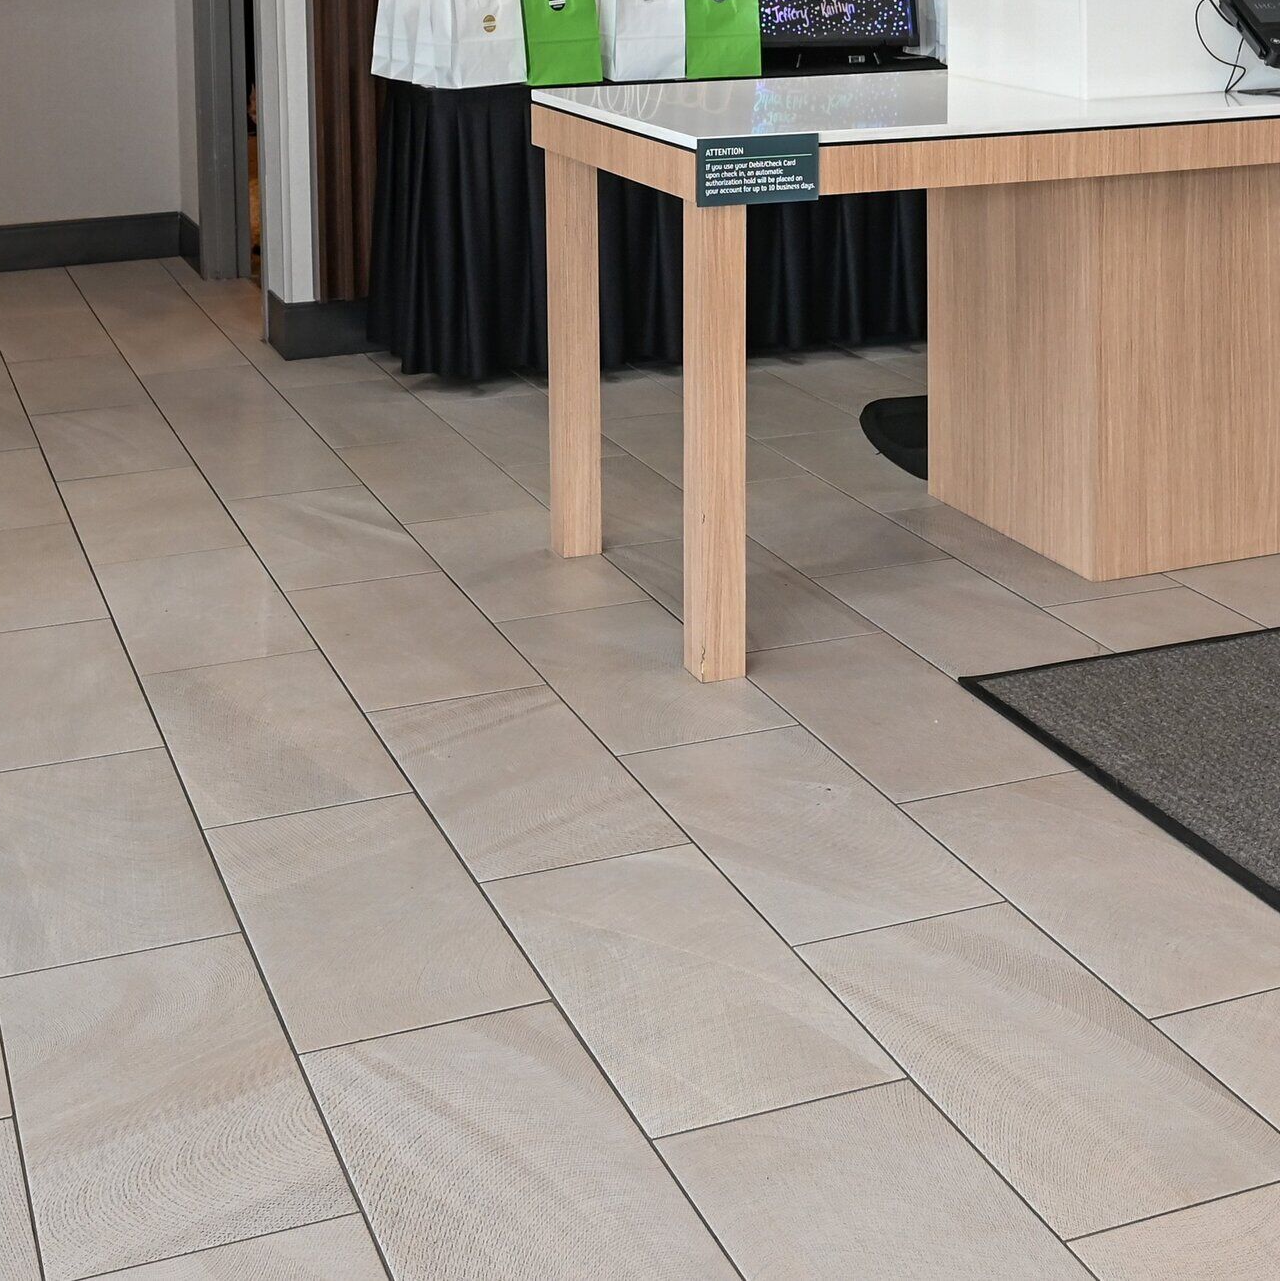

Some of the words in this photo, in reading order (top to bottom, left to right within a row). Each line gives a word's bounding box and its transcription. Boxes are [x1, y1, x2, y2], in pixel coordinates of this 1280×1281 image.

[820, 0, 856, 21] Kaitlyn
[705, 147, 744, 156] ATTENTION
[735, 162, 748, 171] your
[748, 160, 782, 169] Debit/Check
[783, 159, 796, 167] Card
[705, 171, 720, 179] upon
[721, 169, 738, 178] check
[738, 169, 746, 177] in,
[755, 168, 784, 176] automatic
[705, 178, 742, 187] authorization
[743, 177, 756, 185] hold
[756, 176, 767, 184] will
[776, 175, 794, 184] placed
[705, 187, 719, 196] your
[719, 185, 742, 194] account
[743, 184, 751, 193] for
[752, 185, 760, 193] up
[776, 182, 800, 190] business
[800, 181, 816, 190] days.
